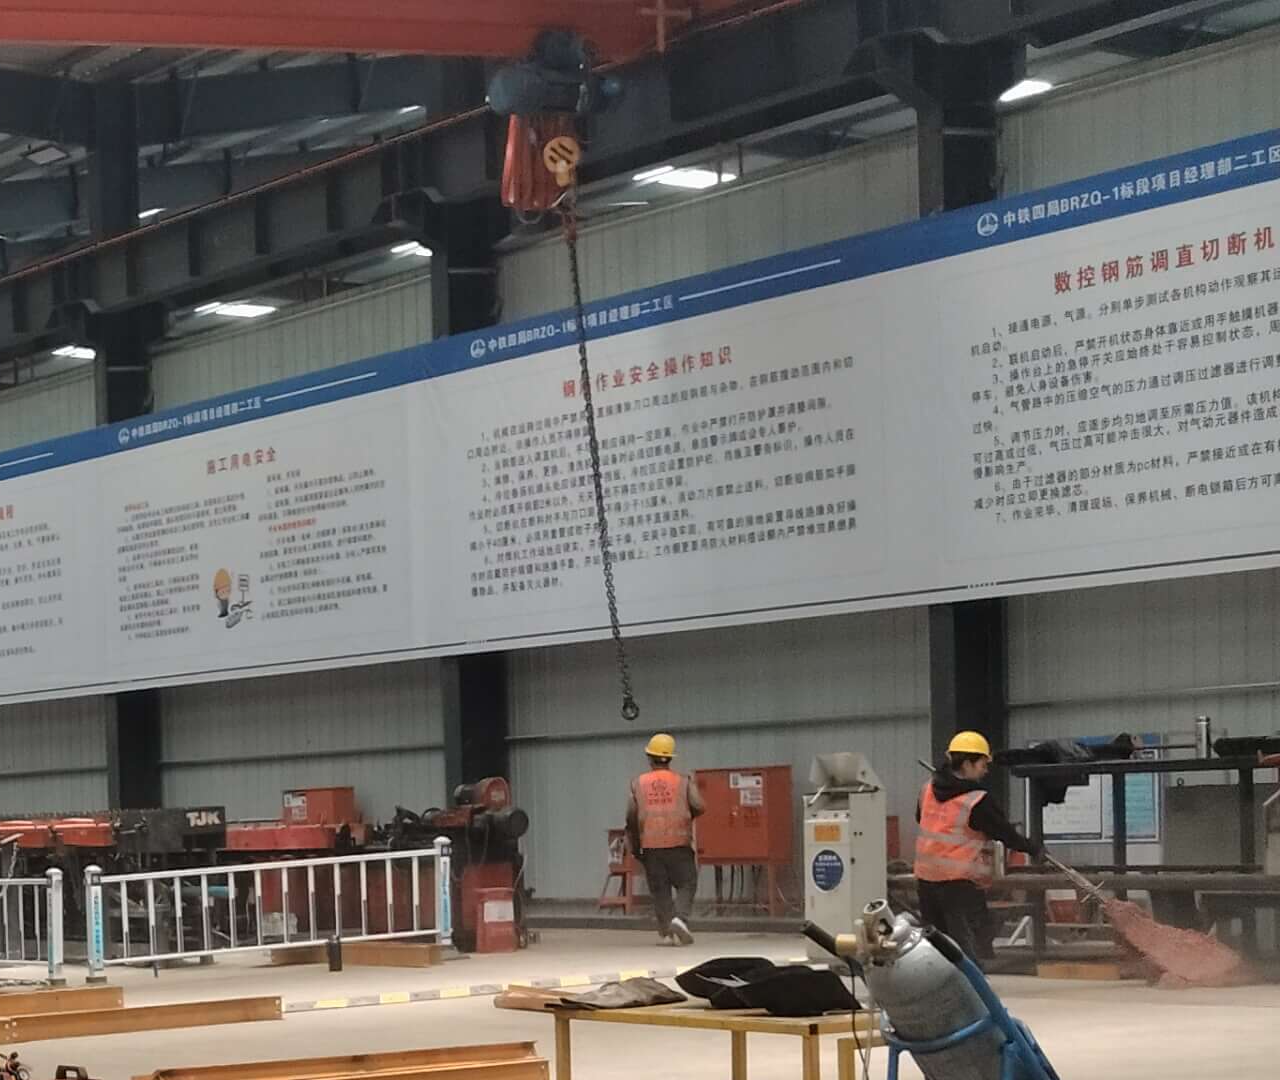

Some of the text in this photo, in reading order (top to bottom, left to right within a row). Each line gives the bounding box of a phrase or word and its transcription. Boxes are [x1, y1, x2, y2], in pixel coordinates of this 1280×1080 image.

[1053, 226, 1275, 295] 数控钢筋调直切断机
[186, 811, 221, 827] TJK
